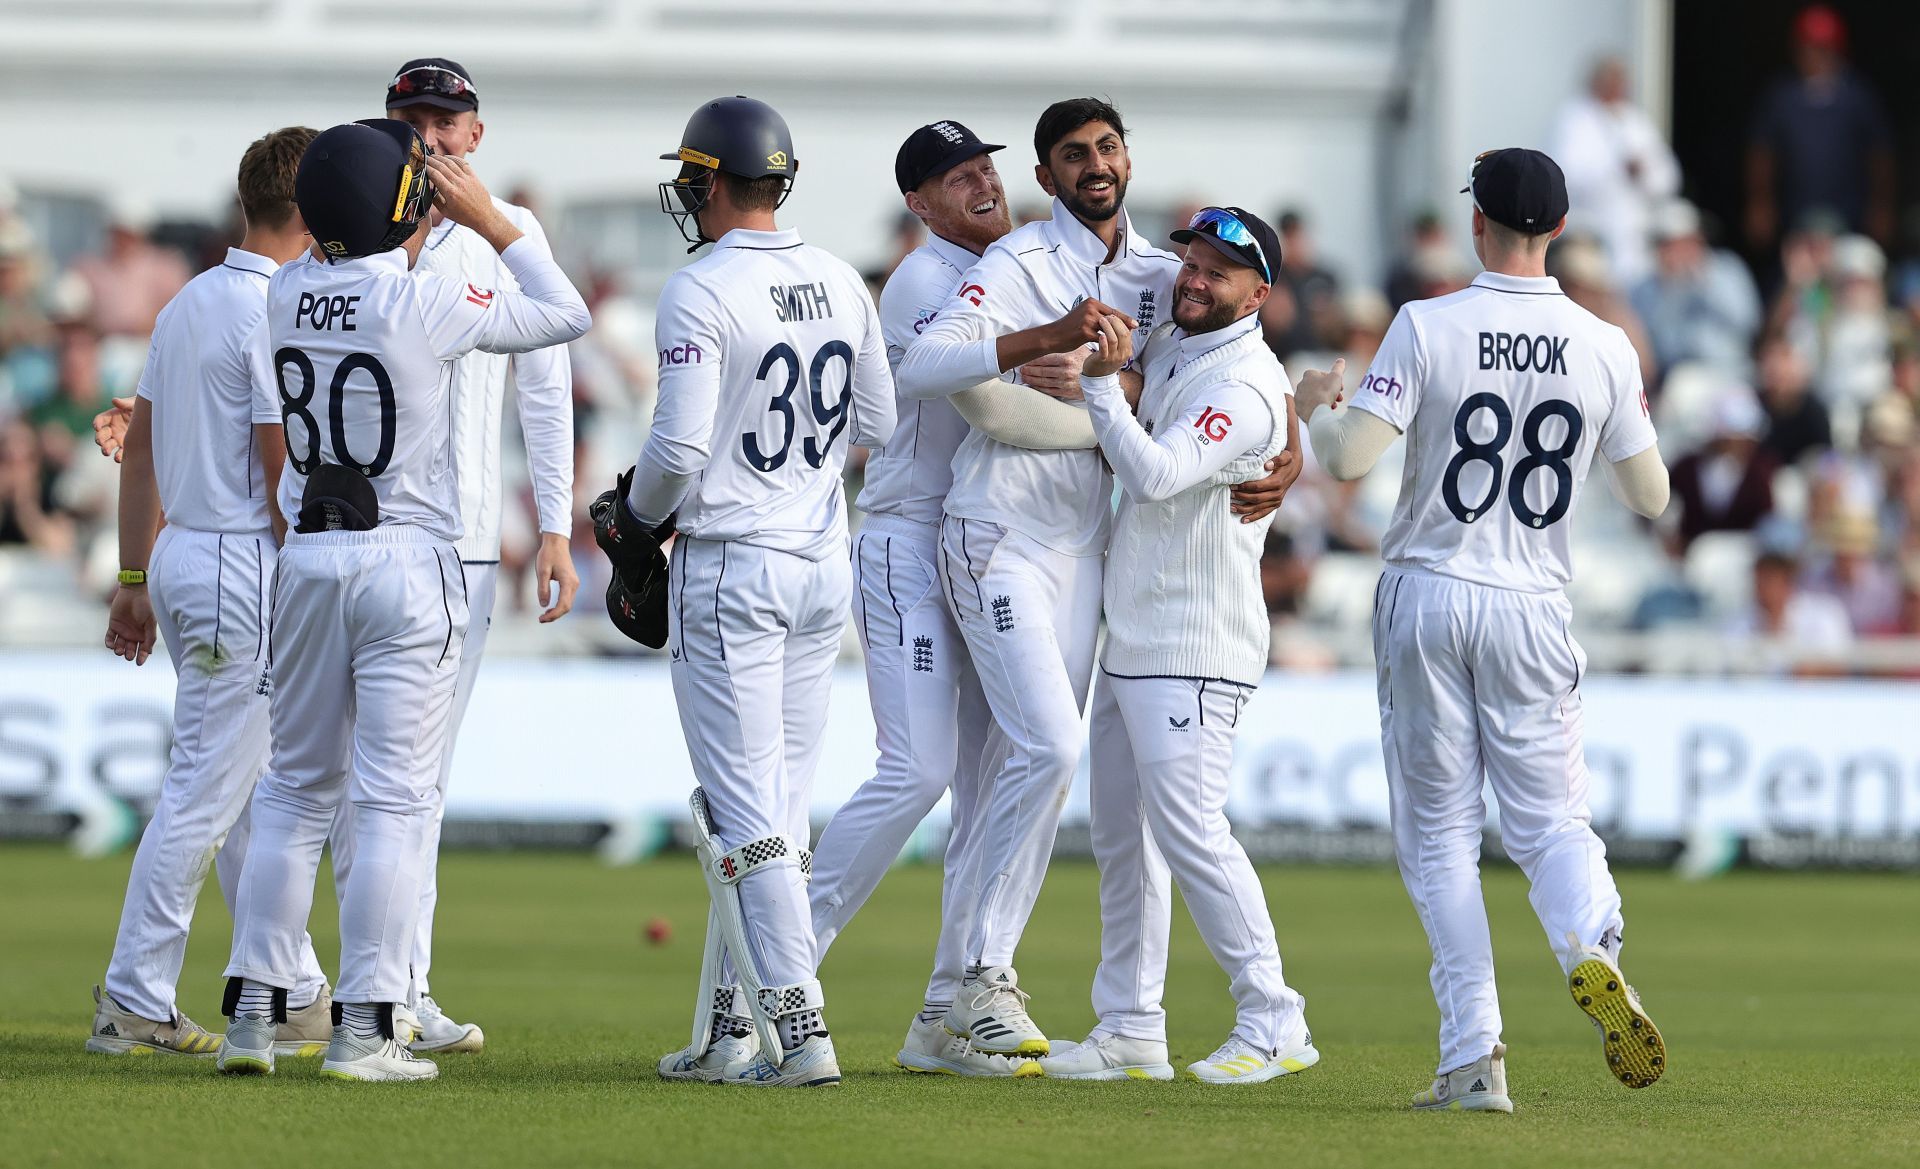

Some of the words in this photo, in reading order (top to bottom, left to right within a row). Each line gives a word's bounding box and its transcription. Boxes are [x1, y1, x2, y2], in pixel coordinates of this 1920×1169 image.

[296, 292, 361, 331] POPE
[770, 282, 832, 322] SMITH
[1479, 332, 1569, 375] BROOK
[275, 347, 396, 478] 80
[742, 340, 852, 472] 39
[1193, 405, 1233, 443] IG
[1442, 392, 1582, 529] 88
